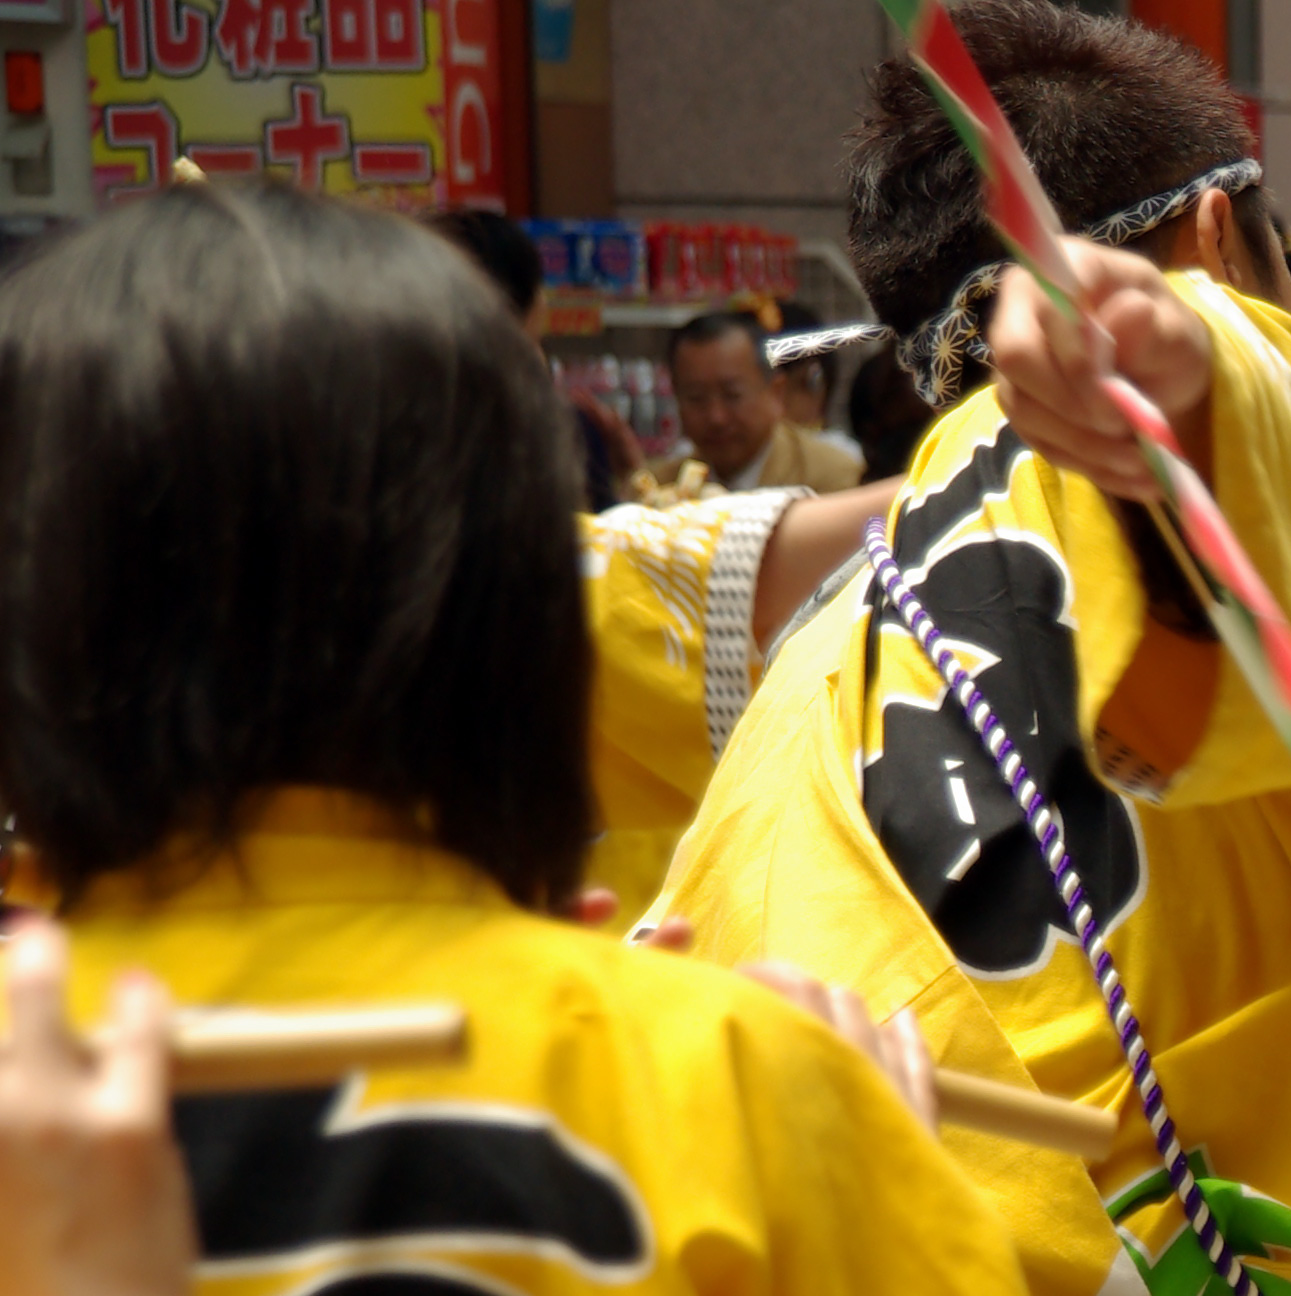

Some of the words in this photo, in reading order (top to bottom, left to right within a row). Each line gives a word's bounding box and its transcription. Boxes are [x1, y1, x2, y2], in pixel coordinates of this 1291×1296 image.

[105, 0, 426, 81] 化粧品
[104, 82, 436, 202] コーナー
